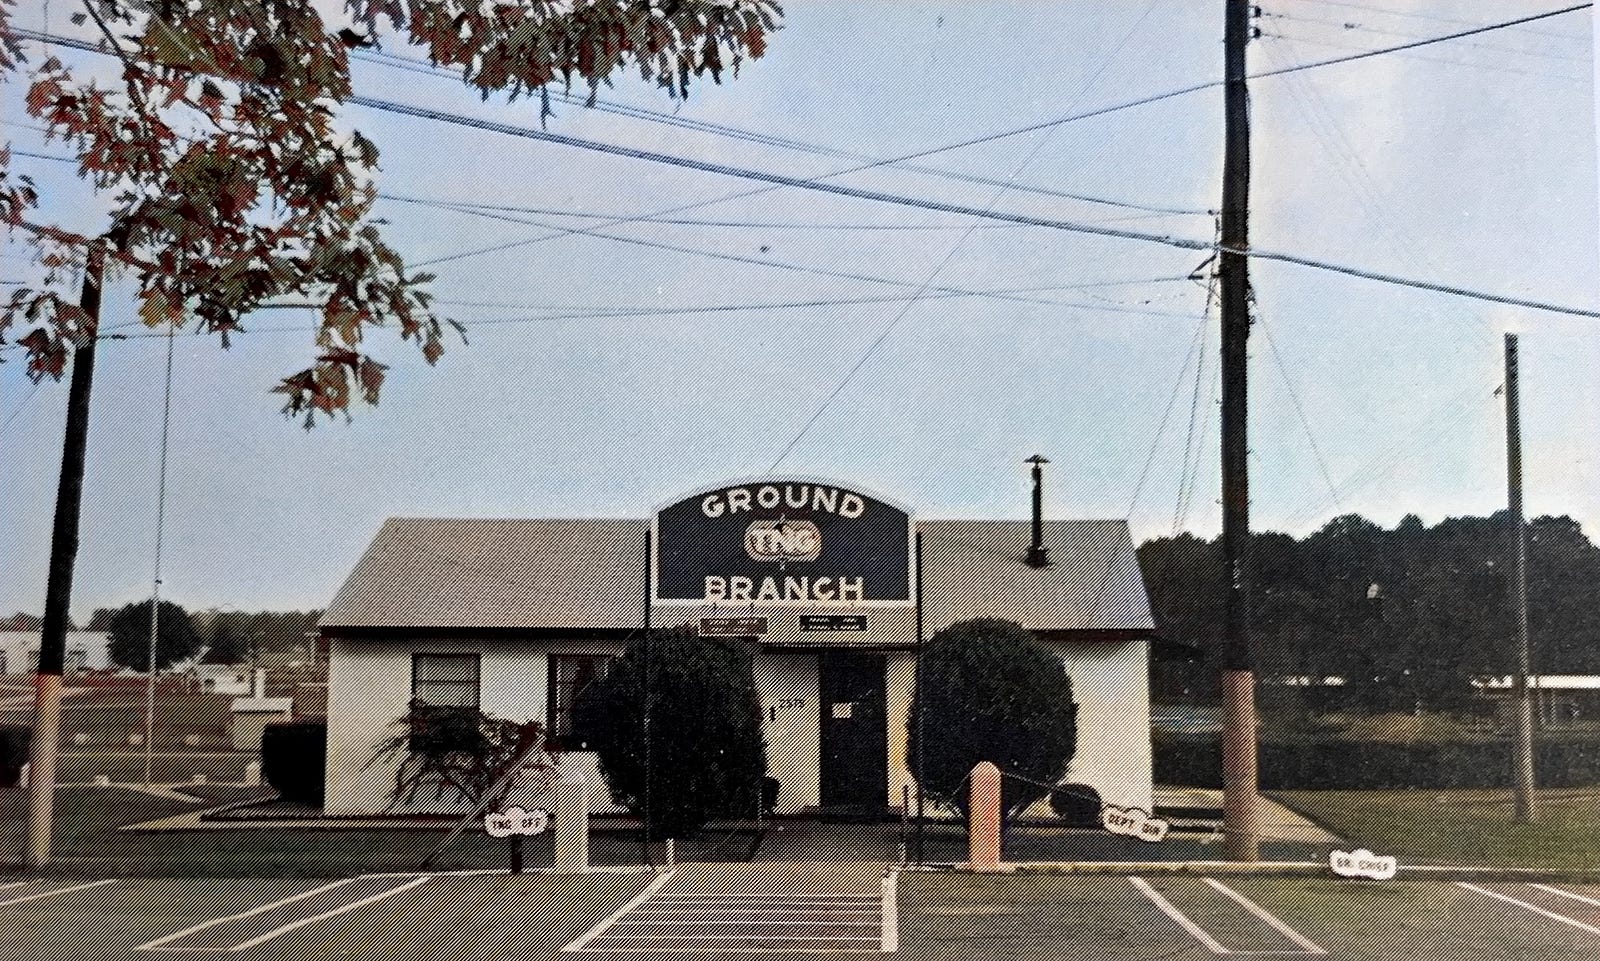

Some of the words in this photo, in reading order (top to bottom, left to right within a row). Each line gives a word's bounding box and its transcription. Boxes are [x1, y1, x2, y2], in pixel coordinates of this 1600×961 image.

[702, 485, 865, 519] GROUND
[750, 525, 815, 555] TNG
[705, 575, 864, 600] BRANCH
[492, 819, 512, 831] TNG
[521, 817, 541, 829] OFF
